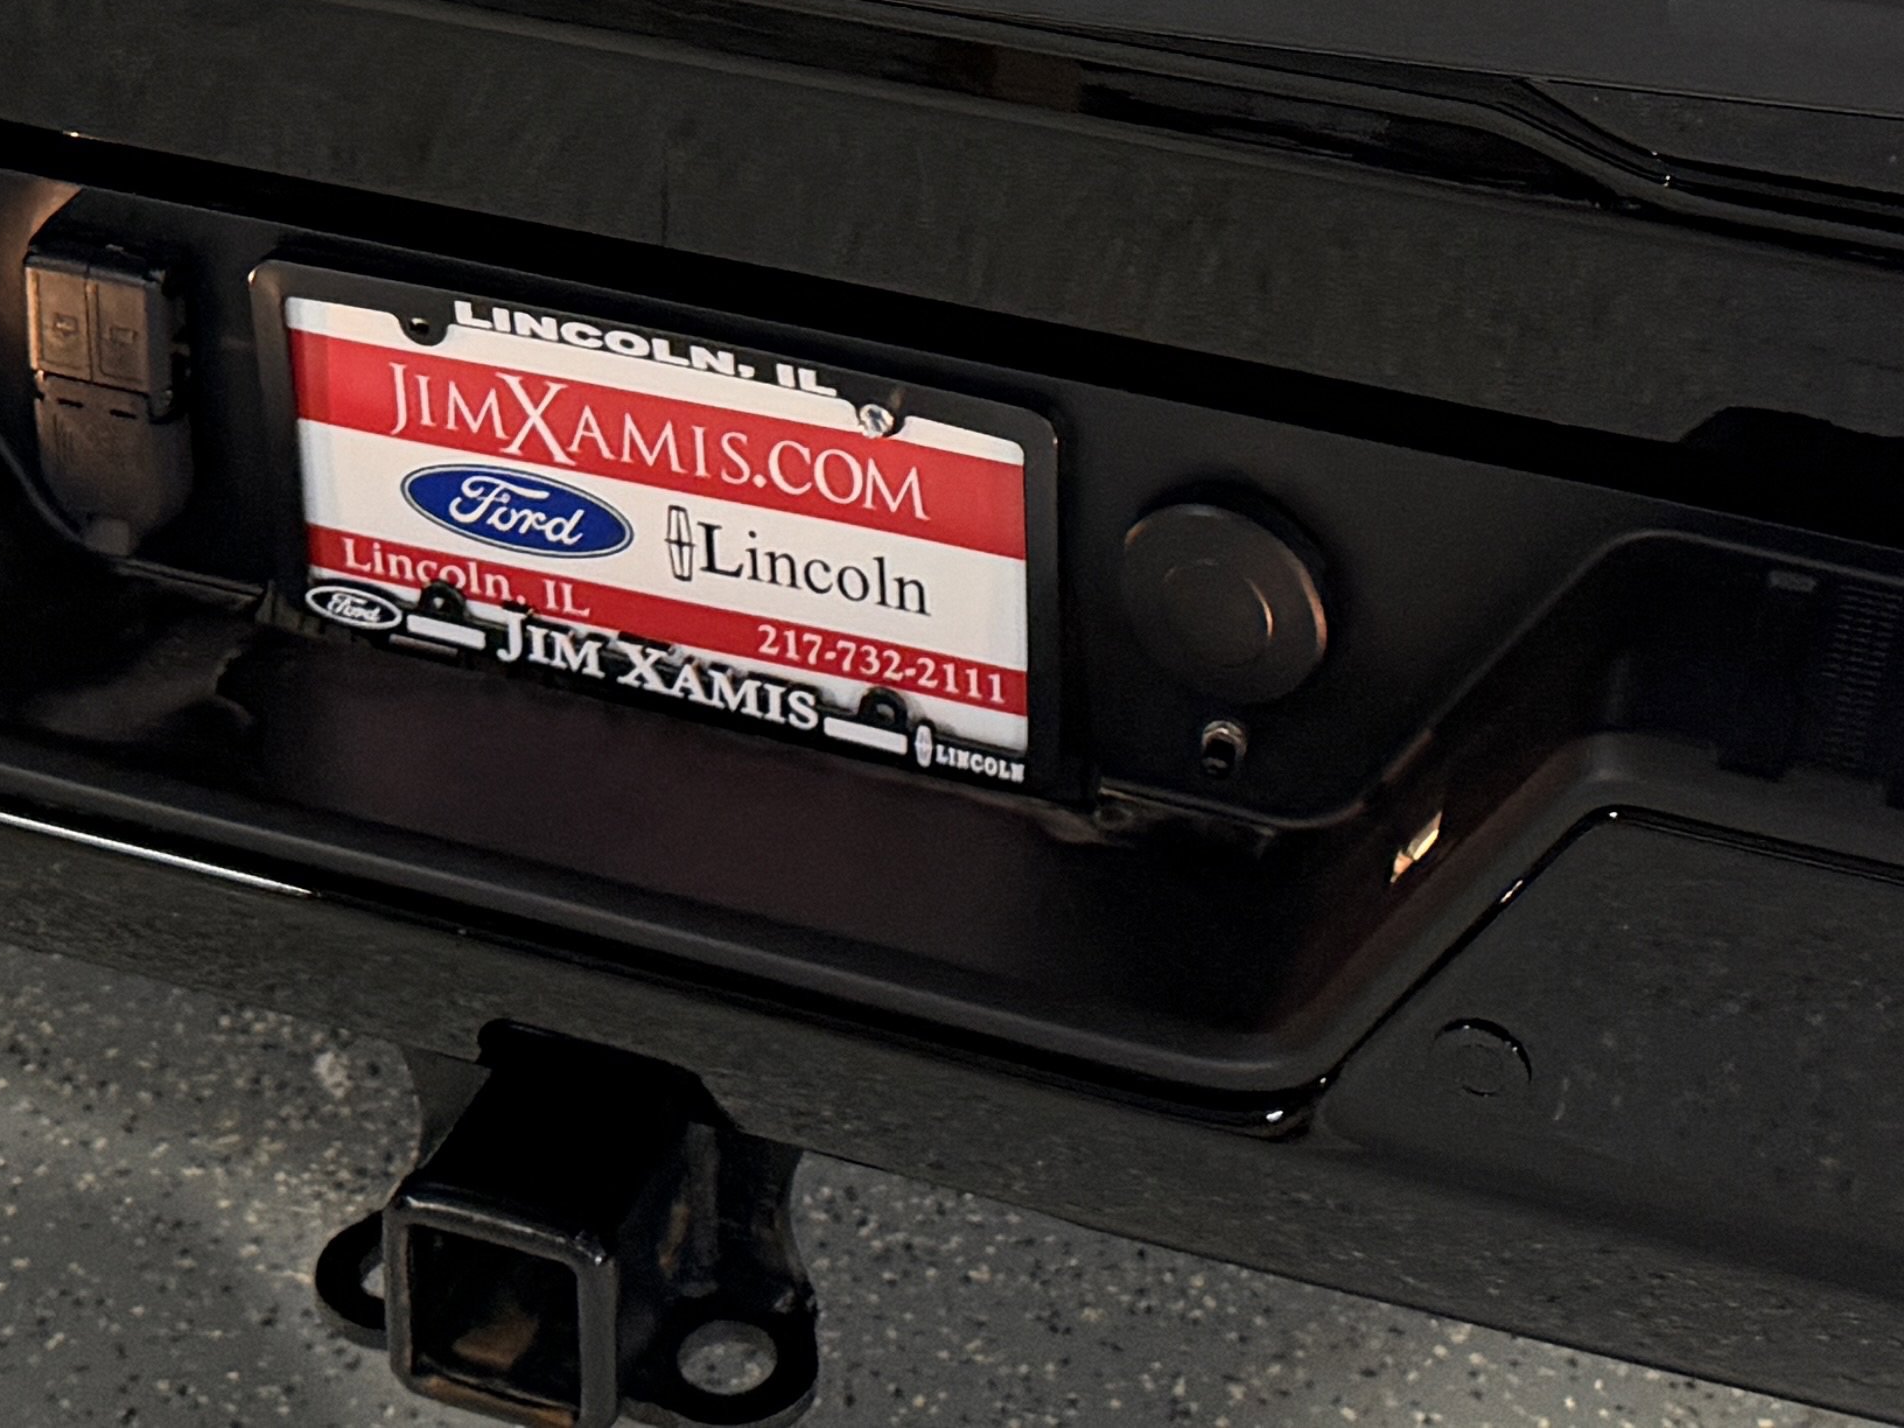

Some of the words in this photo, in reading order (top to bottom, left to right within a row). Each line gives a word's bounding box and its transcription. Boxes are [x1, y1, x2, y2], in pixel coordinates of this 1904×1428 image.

[454, 300, 756, 380] LINCOLN,
[776, 362, 837, 397] IL
[448, 473, 584, 546] Ford
[542, 579, 590, 617] IL
[699, 521, 932, 616] Lincoln
[327, 593, 381, 622] Ford
[496, 610, 600, 679] JIM
[618, 640, 820, 732] XAMIS
[758, 625, 1004, 704] 217-732-2111
[936, 745, 1024, 782] LINCOLN
